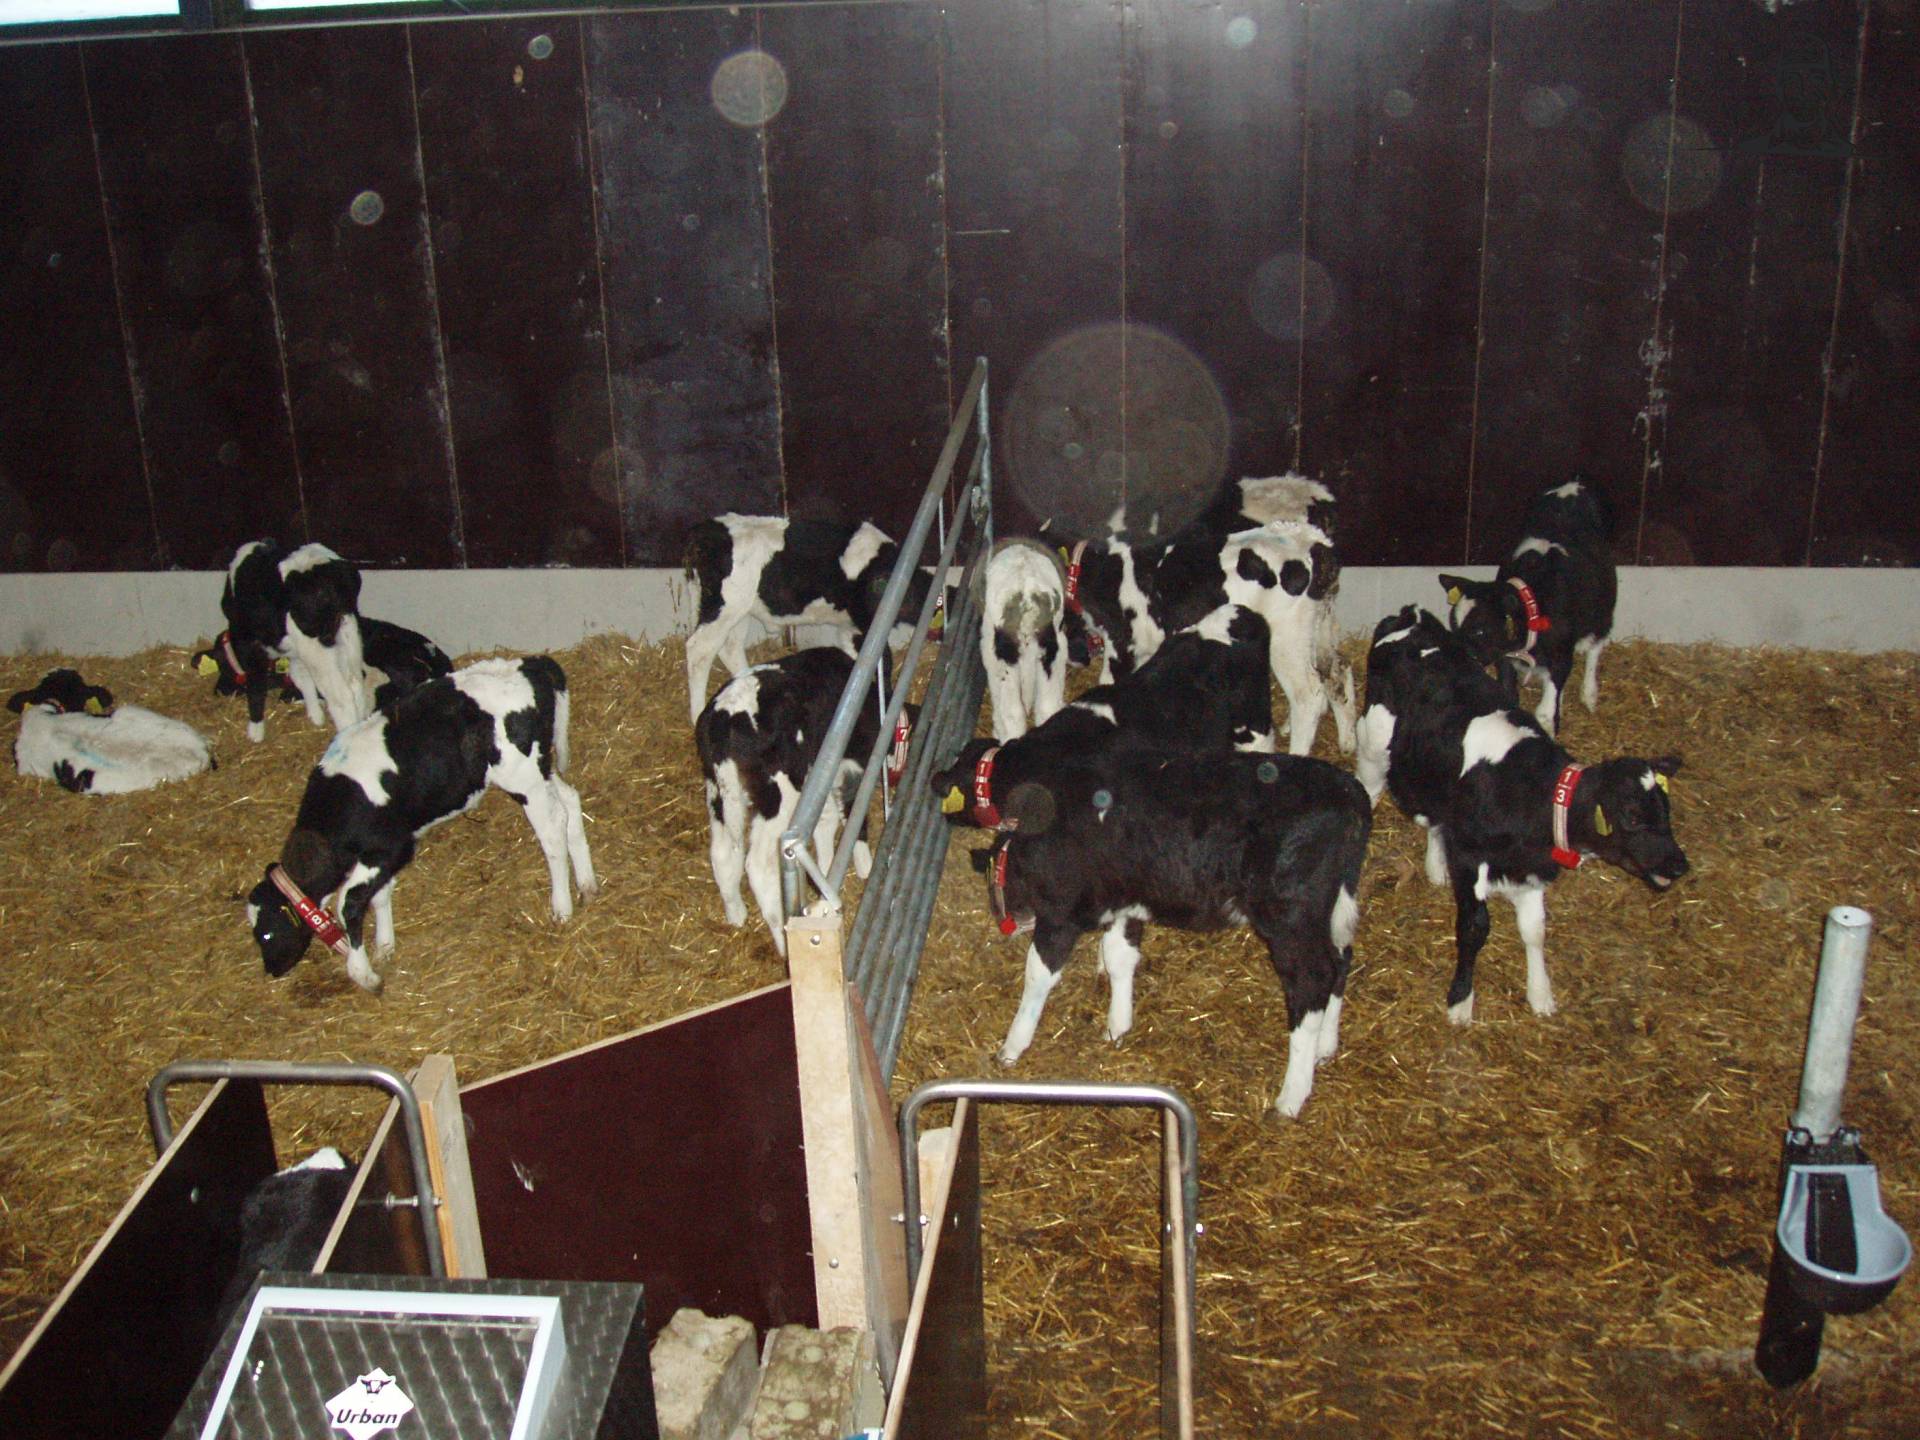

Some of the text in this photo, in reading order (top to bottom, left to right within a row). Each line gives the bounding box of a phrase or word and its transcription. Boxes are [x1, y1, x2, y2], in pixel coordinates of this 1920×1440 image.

[900, 728, 907, 741] 7
[1556, 771, 1572, 803] 13
[300, 903, 323, 925] 18
[336, 1408, 398, 1424] Urban
